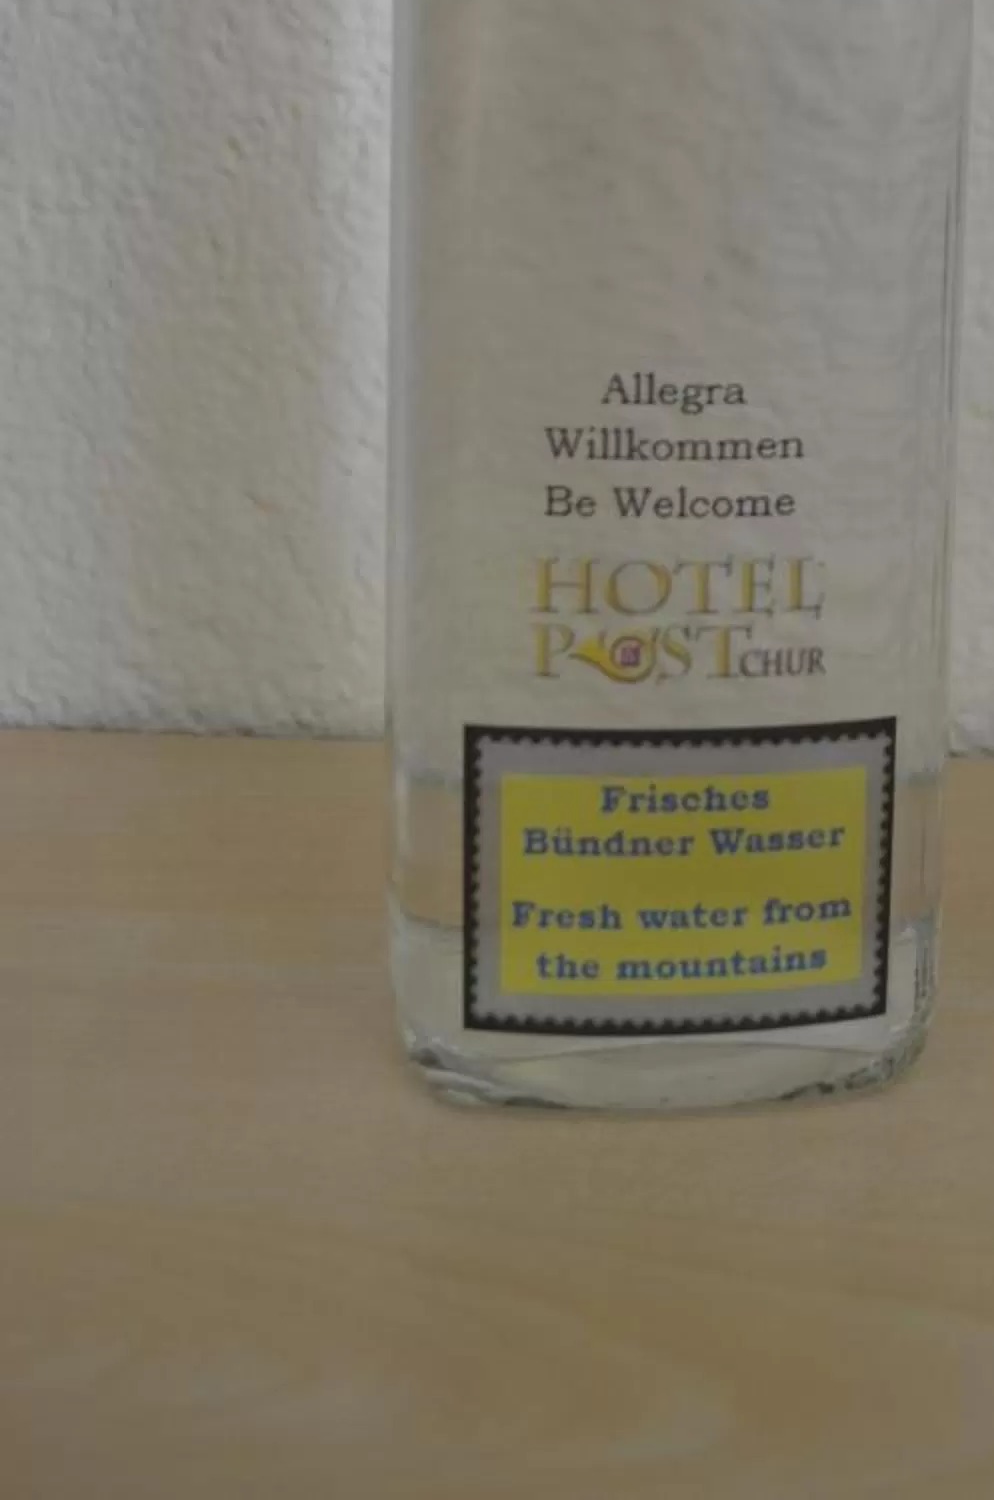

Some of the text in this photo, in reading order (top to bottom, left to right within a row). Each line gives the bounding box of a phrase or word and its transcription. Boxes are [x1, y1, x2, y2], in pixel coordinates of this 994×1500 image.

[601, 372, 746, 414] Allegra
[544, 426, 803, 461] Willkommen
[544, 485, 796, 518] Be Welcome
[529, 553, 826, 619] HOTEL
[739, 647, 825, 677] CHUR
[600, 782, 770, 813] Frisches
[523, 826, 845, 856] Bündner Wasser
[512, 897, 851, 930] Fresh water from
[536, 946, 827, 980] the mountains
